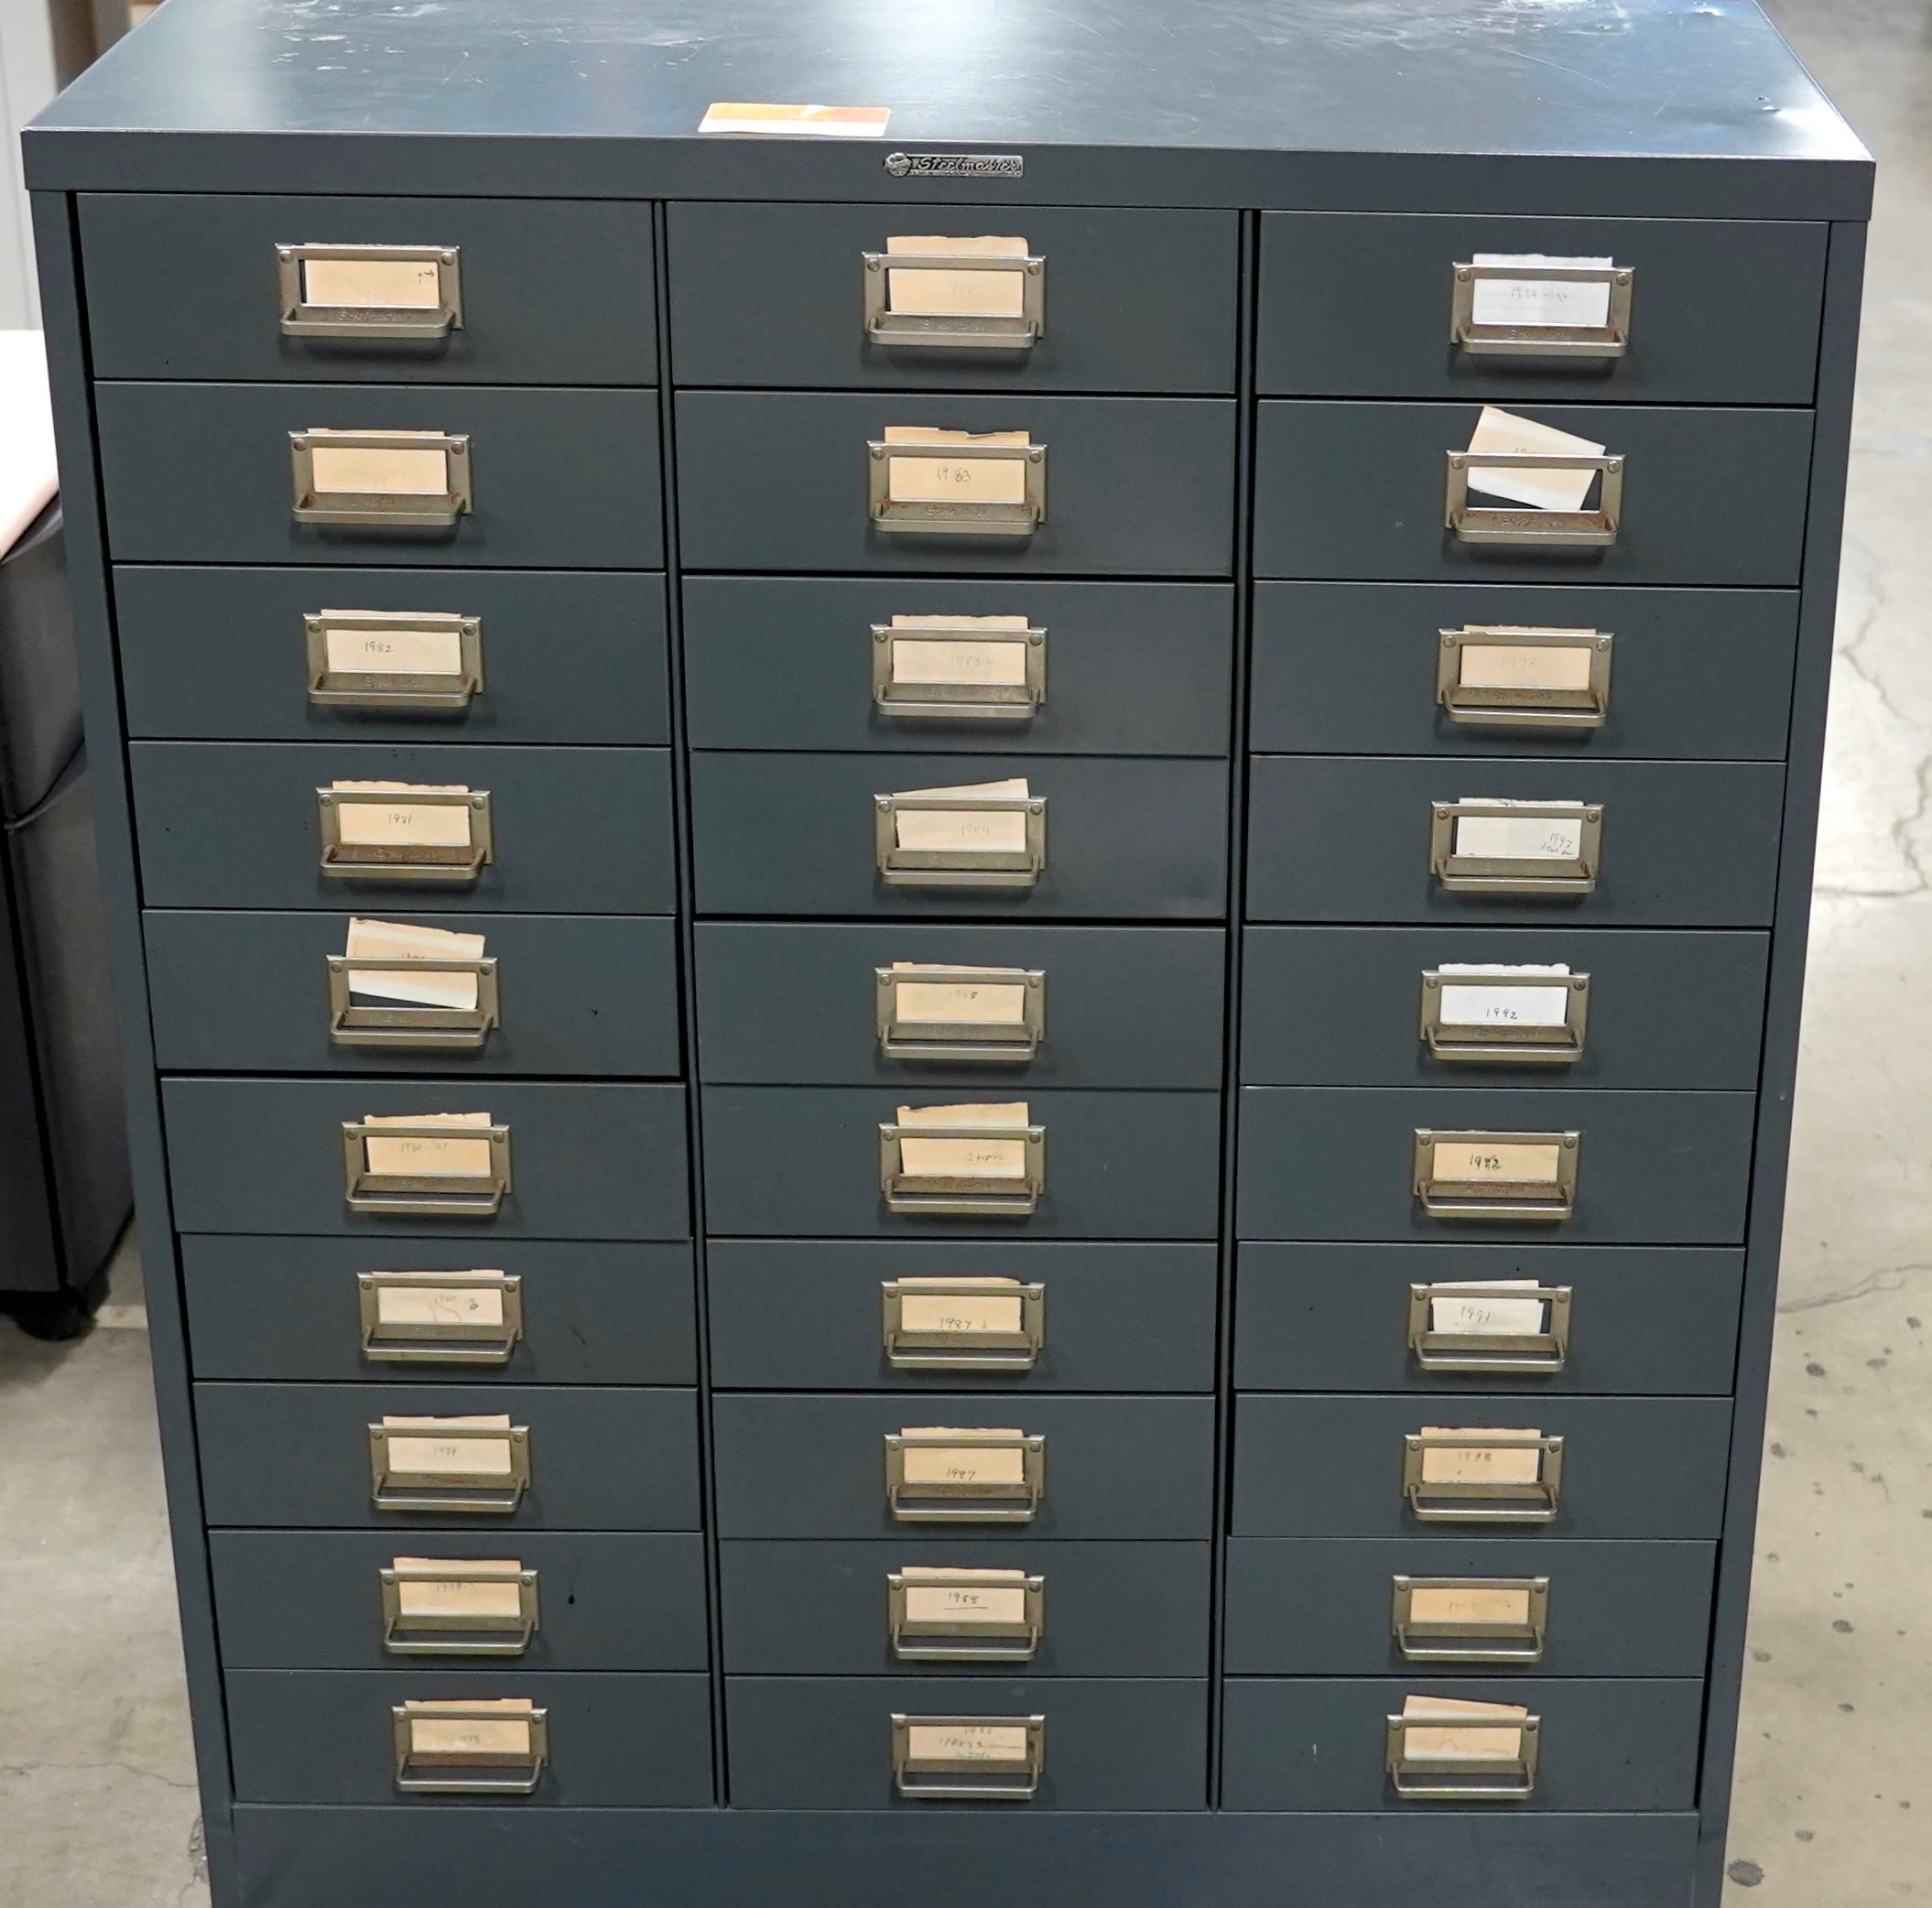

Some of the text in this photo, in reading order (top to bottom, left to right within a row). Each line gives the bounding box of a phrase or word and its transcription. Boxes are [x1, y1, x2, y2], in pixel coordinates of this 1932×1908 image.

[917, 156, 1022, 173] Steelmaster
[937, 467, 971, 482] 1983
[364, 640, 394, 653] 1982
[388, 813, 412, 825] 1981
[1486, 1007, 1518, 1020] 1992
[1460, 1306, 1491, 1322] 1991
[939, 1317, 972, 1330] 1987
[947, 1467, 976, 1480] 1987
